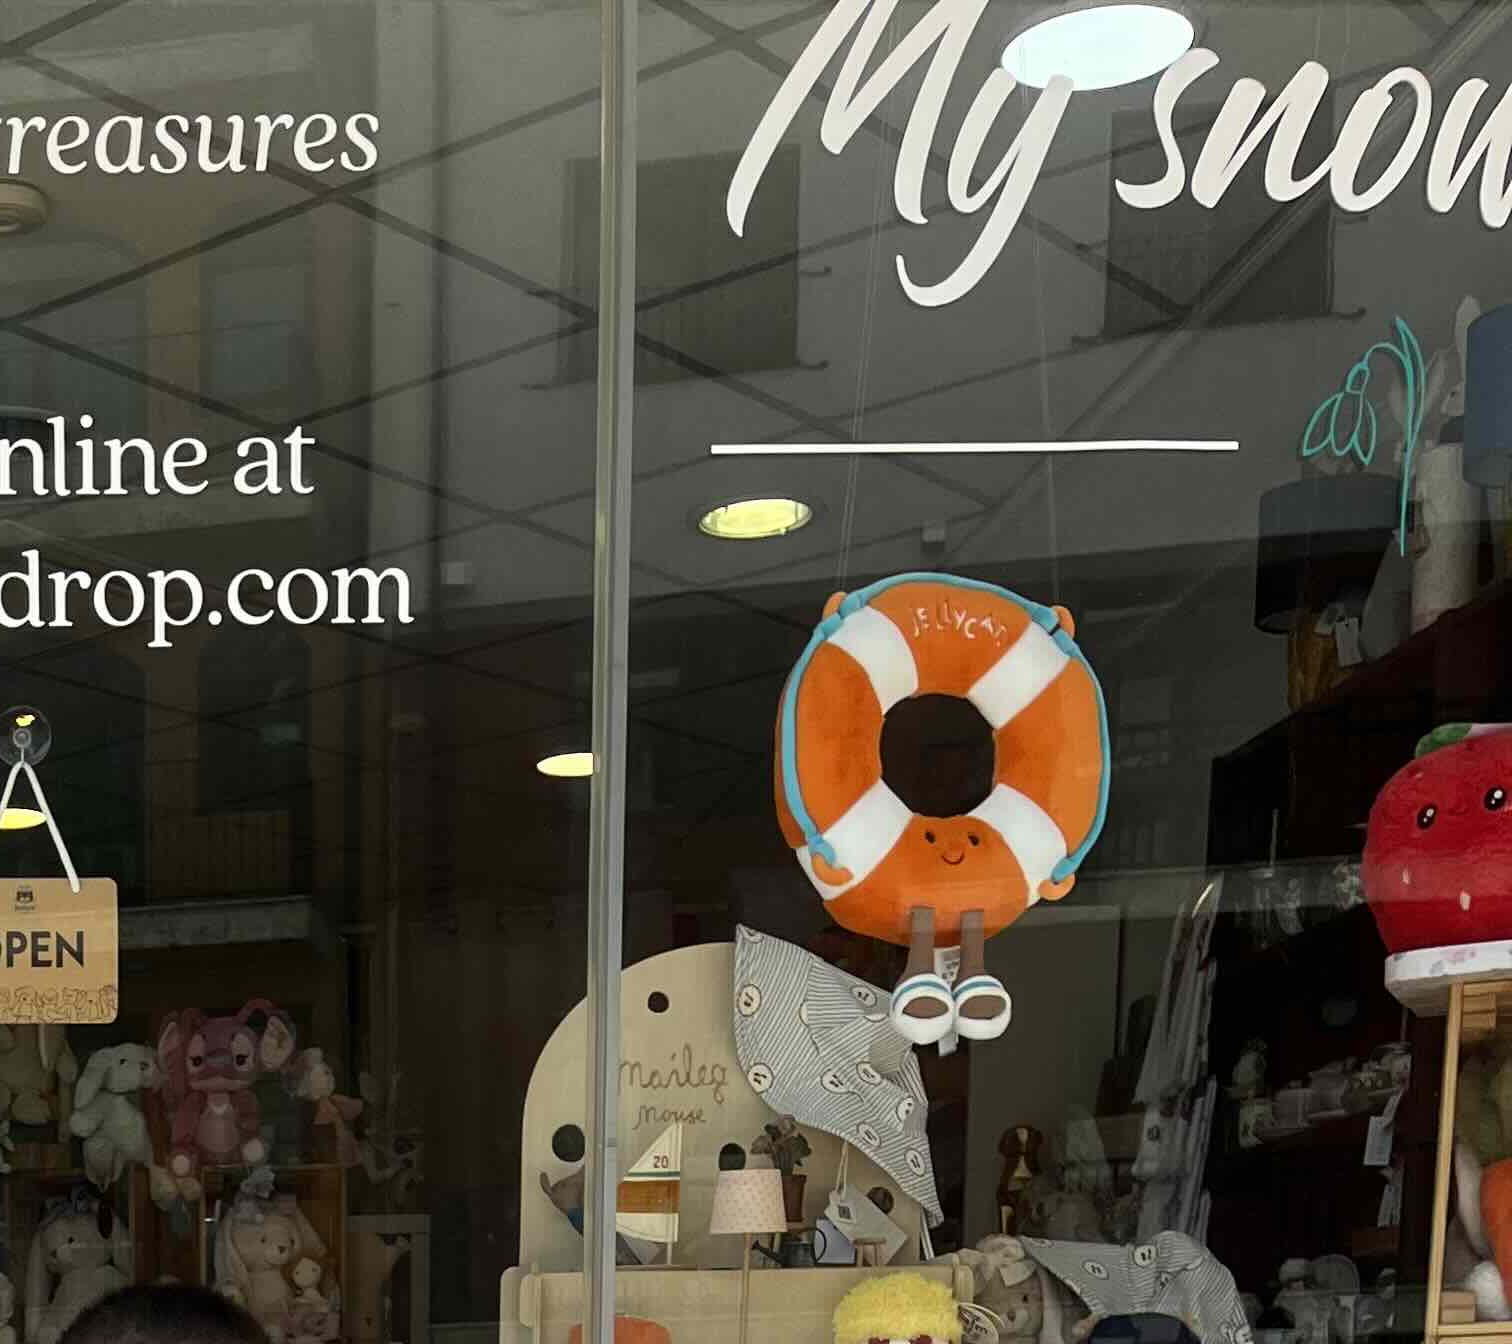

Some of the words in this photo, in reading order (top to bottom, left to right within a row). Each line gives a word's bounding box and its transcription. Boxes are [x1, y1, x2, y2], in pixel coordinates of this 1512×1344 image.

[726, 0, 1075, 307] My
[232, 424, 316, 496] at
[653, 1155, 669, 1169] 20
